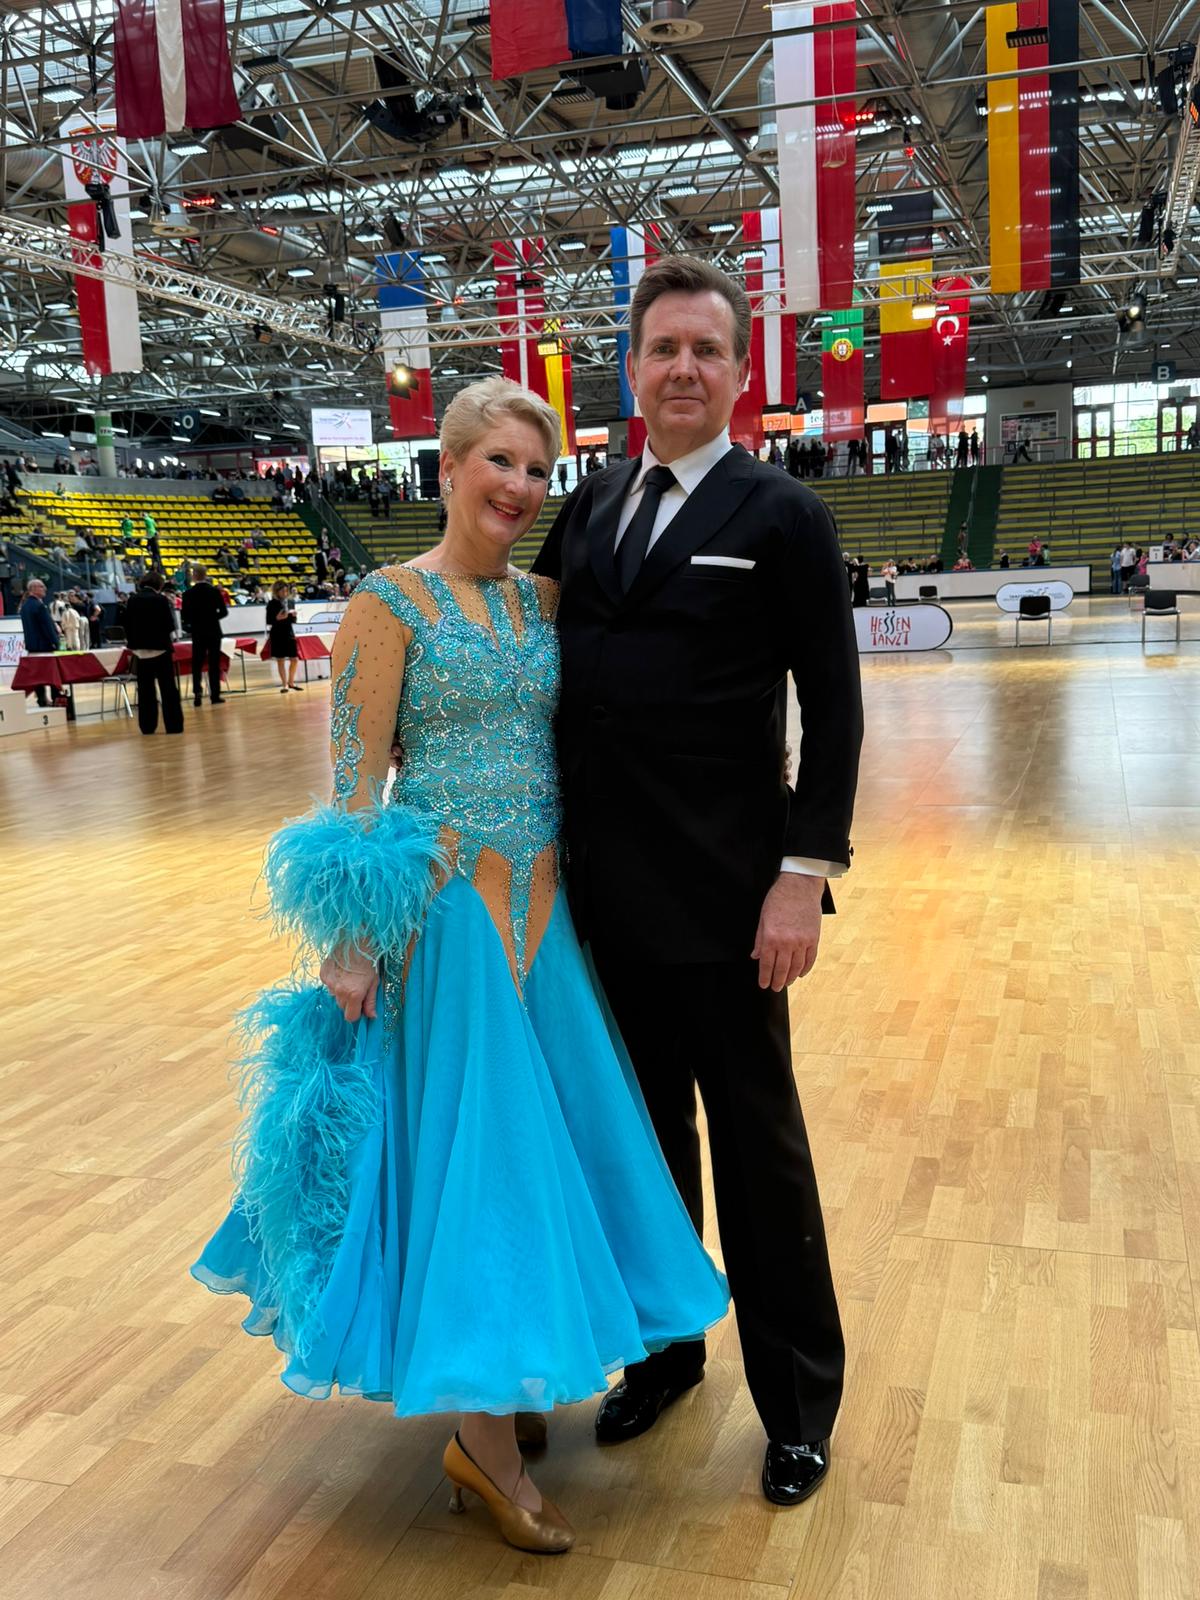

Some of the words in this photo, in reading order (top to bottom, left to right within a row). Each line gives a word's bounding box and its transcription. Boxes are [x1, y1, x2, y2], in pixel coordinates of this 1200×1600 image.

[1157, 365, 1170, 380] B
[795, 397, 807, 412] A
[870, 610, 911, 635] HESSEN
[870, 630, 910, 646] TANZT
[42, 714, 49, 726] 3
